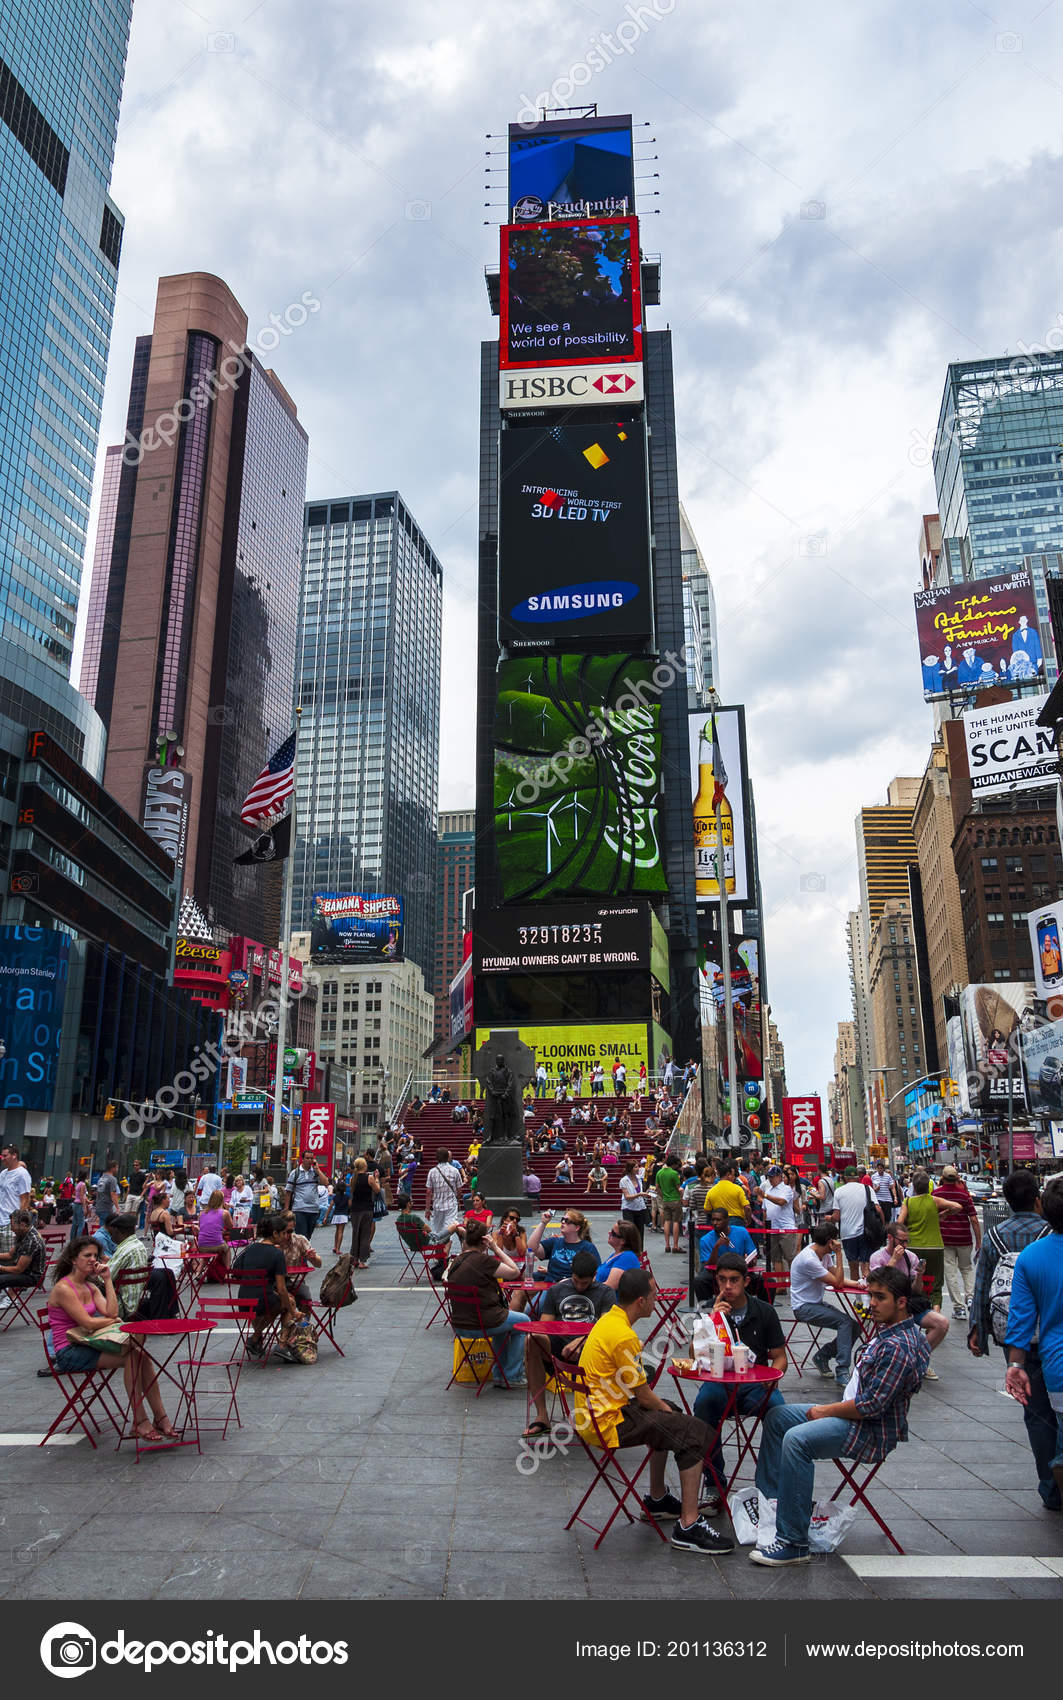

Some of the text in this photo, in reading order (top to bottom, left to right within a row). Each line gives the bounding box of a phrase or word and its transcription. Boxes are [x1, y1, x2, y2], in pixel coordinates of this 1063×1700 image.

[511, 322, 571, 334] We see a
[511, 332, 629, 349] world of possibility.
[505, 375, 588, 399] HSBC
[531, 503, 610, 522] 3D LED TV
[567, 498, 622, 509] WORLD'S FIRST
[915, 587, 951, 600] NATHAN
[989, 579, 1031, 594] NEUWIRTH
[527, 592, 623, 611] SAMSUNG
[916, 598, 937, 609] LANE
[954, 595, 992, 610] The
[934, 606, 1017, 629] Addams
[943, 621, 1014, 642] Family
[969, 718, 988, 729] THE
[990, 708, 1035, 725] HUMANE
[969, 719, 1037, 740] OF THE UNITE
[973, 763, 1057, 788] HUMANEWATC
[178, 802, 188, 855] Chocolate
[324, 898, 398, 914] BANANA SHPEEL
[482, 951, 640, 967] HYUNDAI OWNERS CAN'T BE WRONG.
[0, 966, 56, 980] Morgan Stanley
[600, 1043, 642, 1056] SMALL
[309, 1106, 329, 1150] tkts
[792, 1101, 816, 1148] tkts
